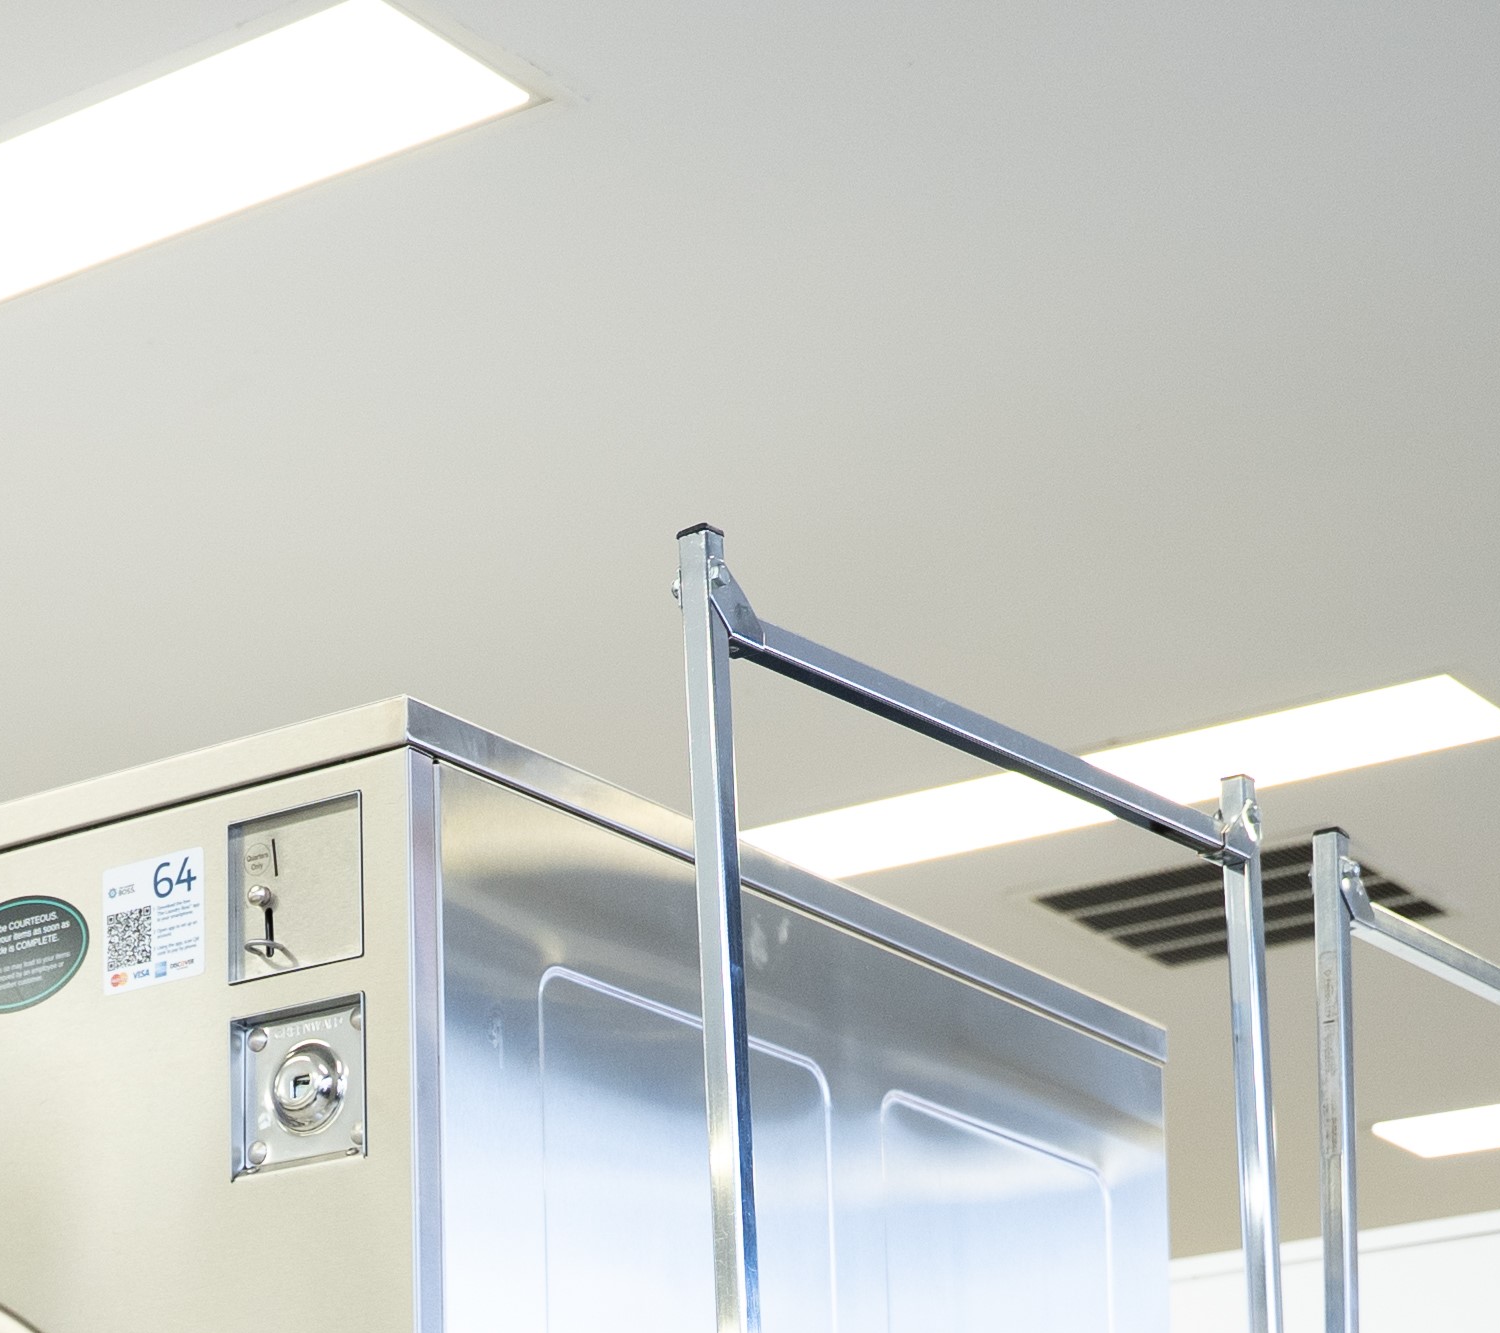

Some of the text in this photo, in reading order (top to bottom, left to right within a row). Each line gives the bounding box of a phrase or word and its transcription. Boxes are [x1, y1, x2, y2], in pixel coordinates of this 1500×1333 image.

[153, 856, 197, 898] 64
[8, 911, 58, 930] COURTEOUS.
[13, 930, 31, 940] items
[43, 923, 60, 933] soon
[61, 920, 70, 929] as
